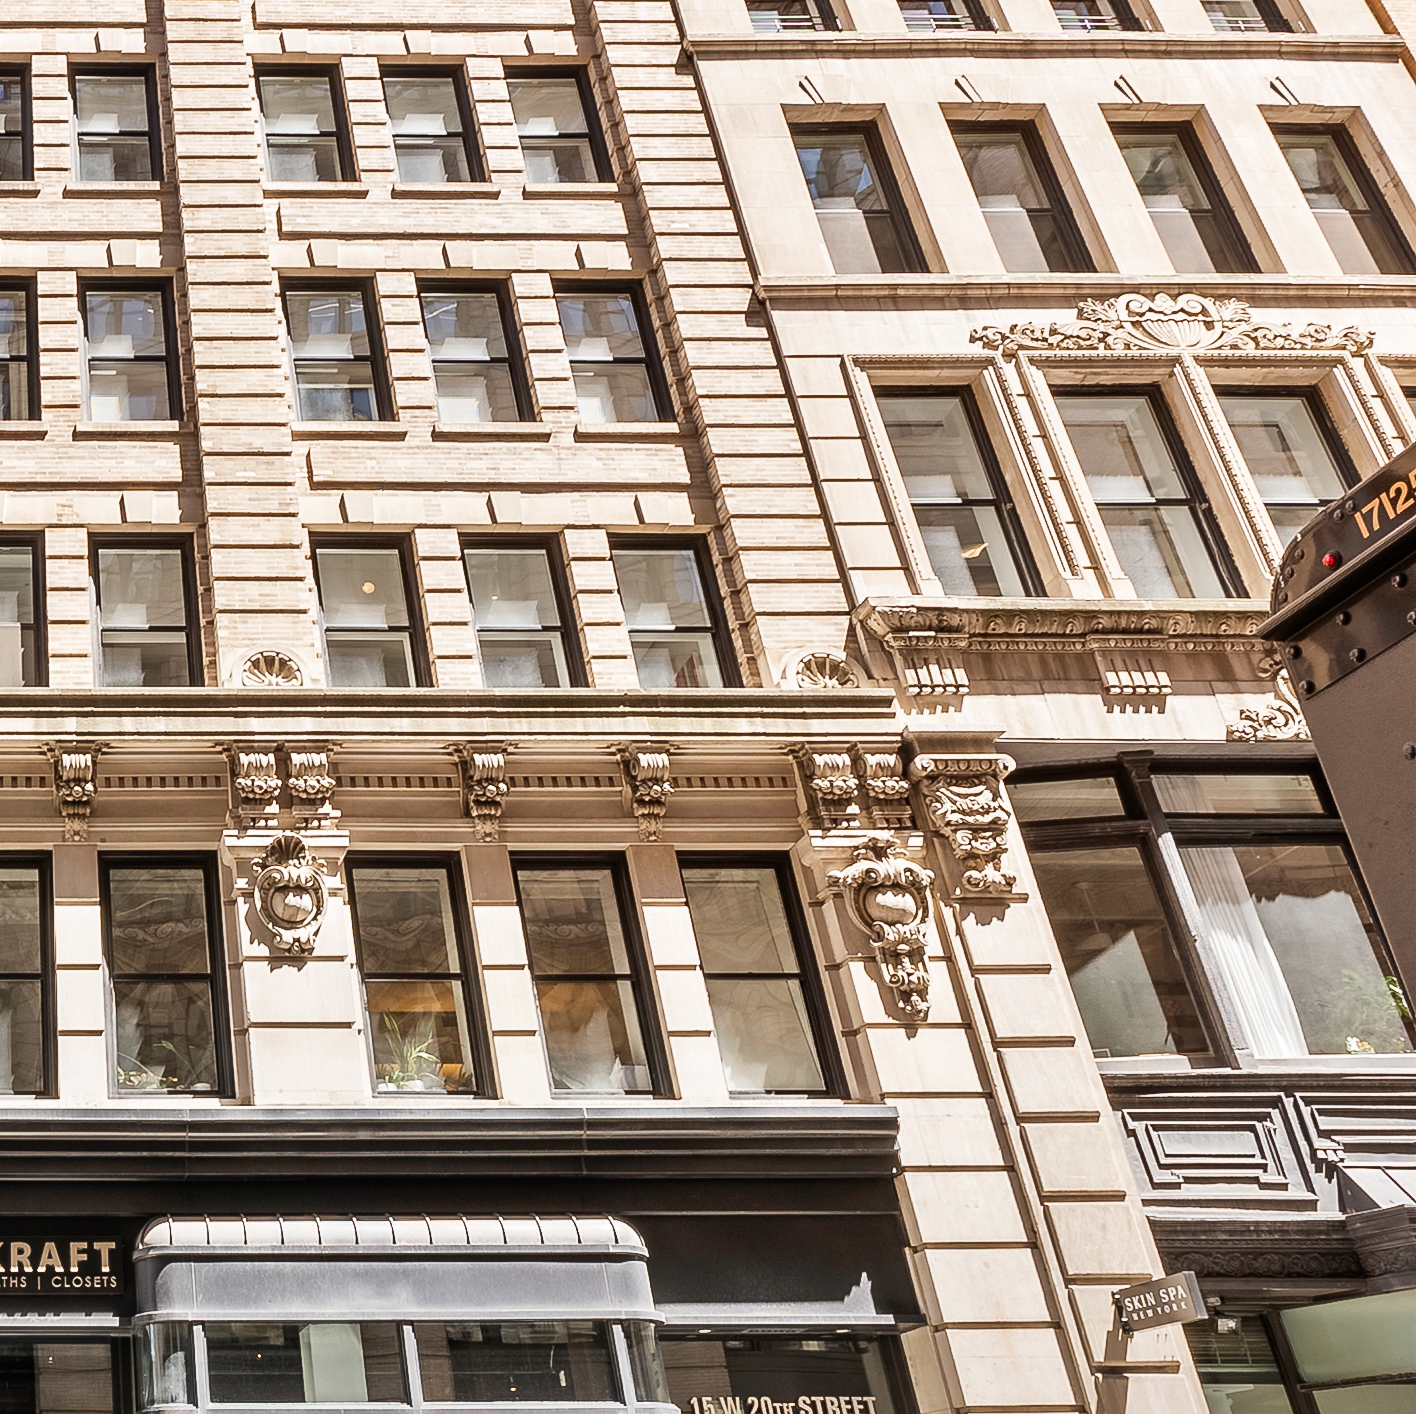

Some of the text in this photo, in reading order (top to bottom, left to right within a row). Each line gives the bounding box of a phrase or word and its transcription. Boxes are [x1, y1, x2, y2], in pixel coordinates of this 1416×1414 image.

[51, 1276, 117, 1288] CLOSETS
[1124, 1284, 1188, 1312] SKIN SPA
[1131, 1300, 1188, 1321] NEW YORK
